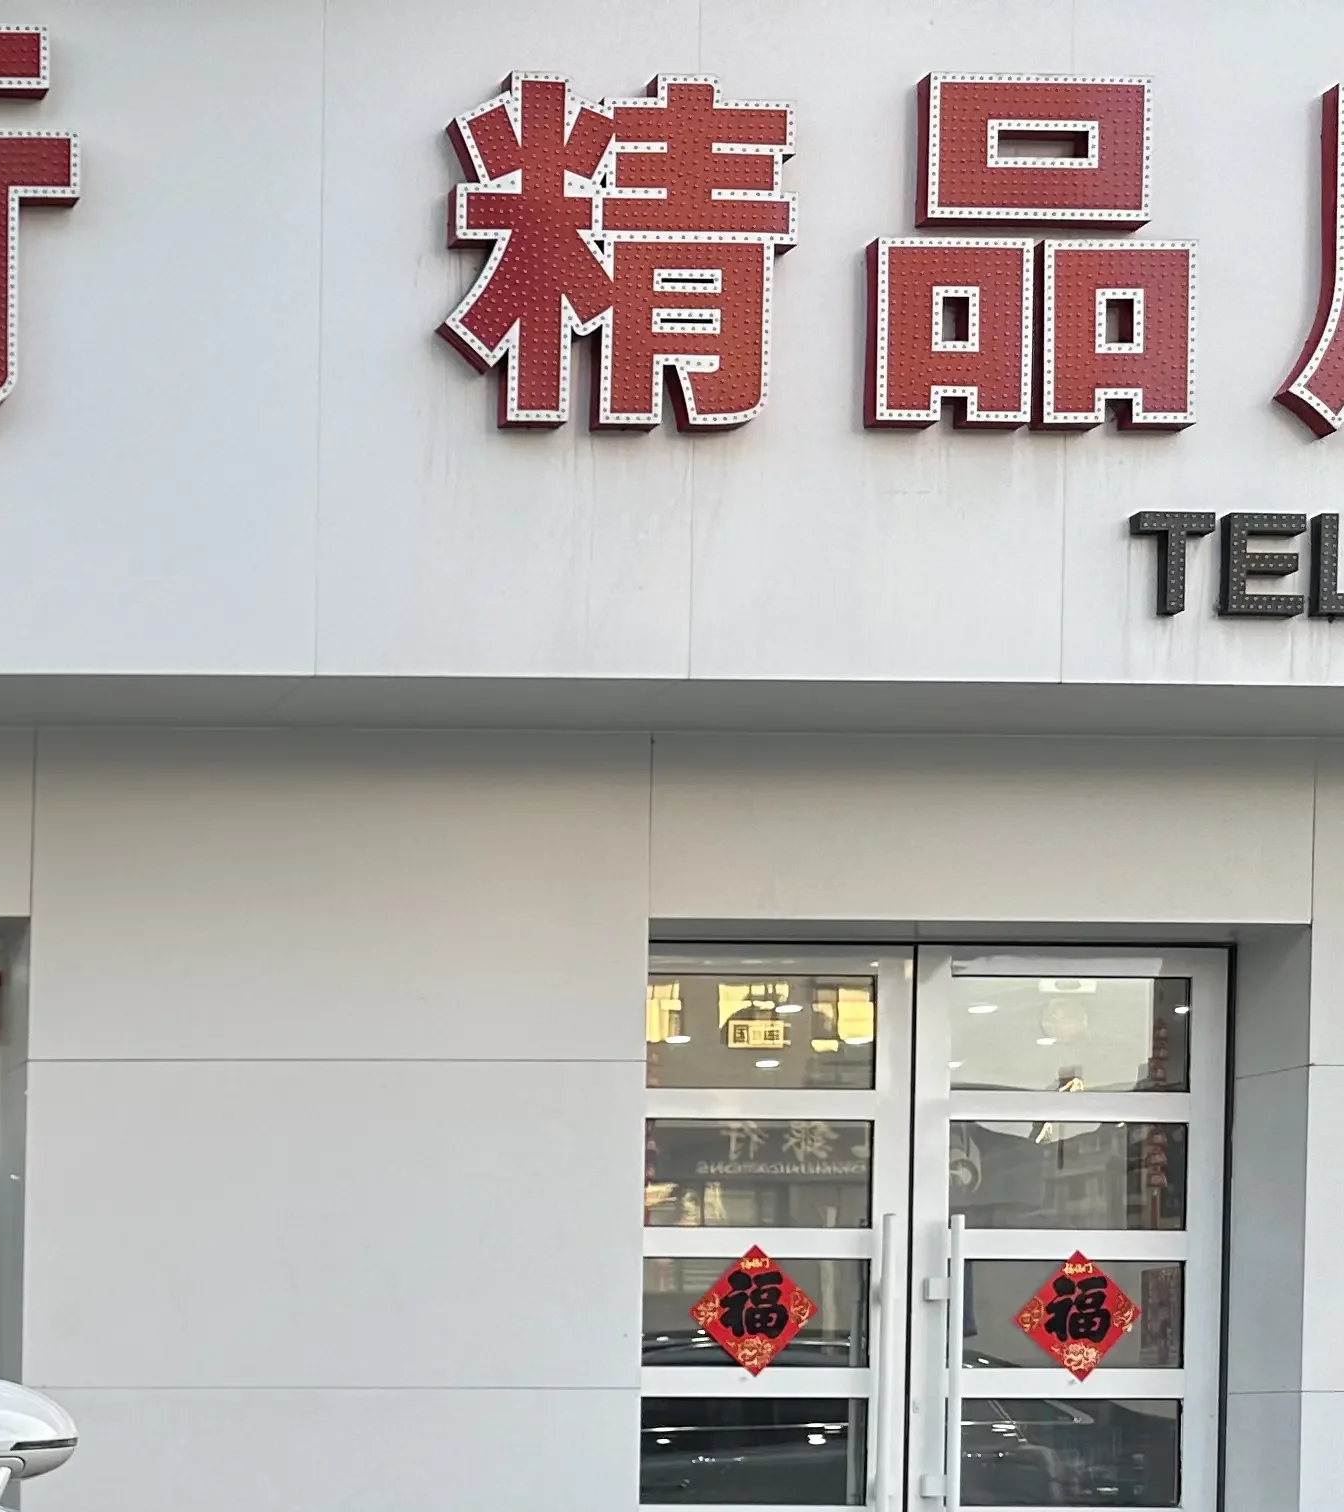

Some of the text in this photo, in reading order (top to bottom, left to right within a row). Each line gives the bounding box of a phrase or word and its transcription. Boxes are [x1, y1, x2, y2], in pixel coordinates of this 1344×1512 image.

[436, 70, 1344, 440] 精品
[720, 1271, 790, 1339] 福
[1044, 1276, 1111, 1343] 福
